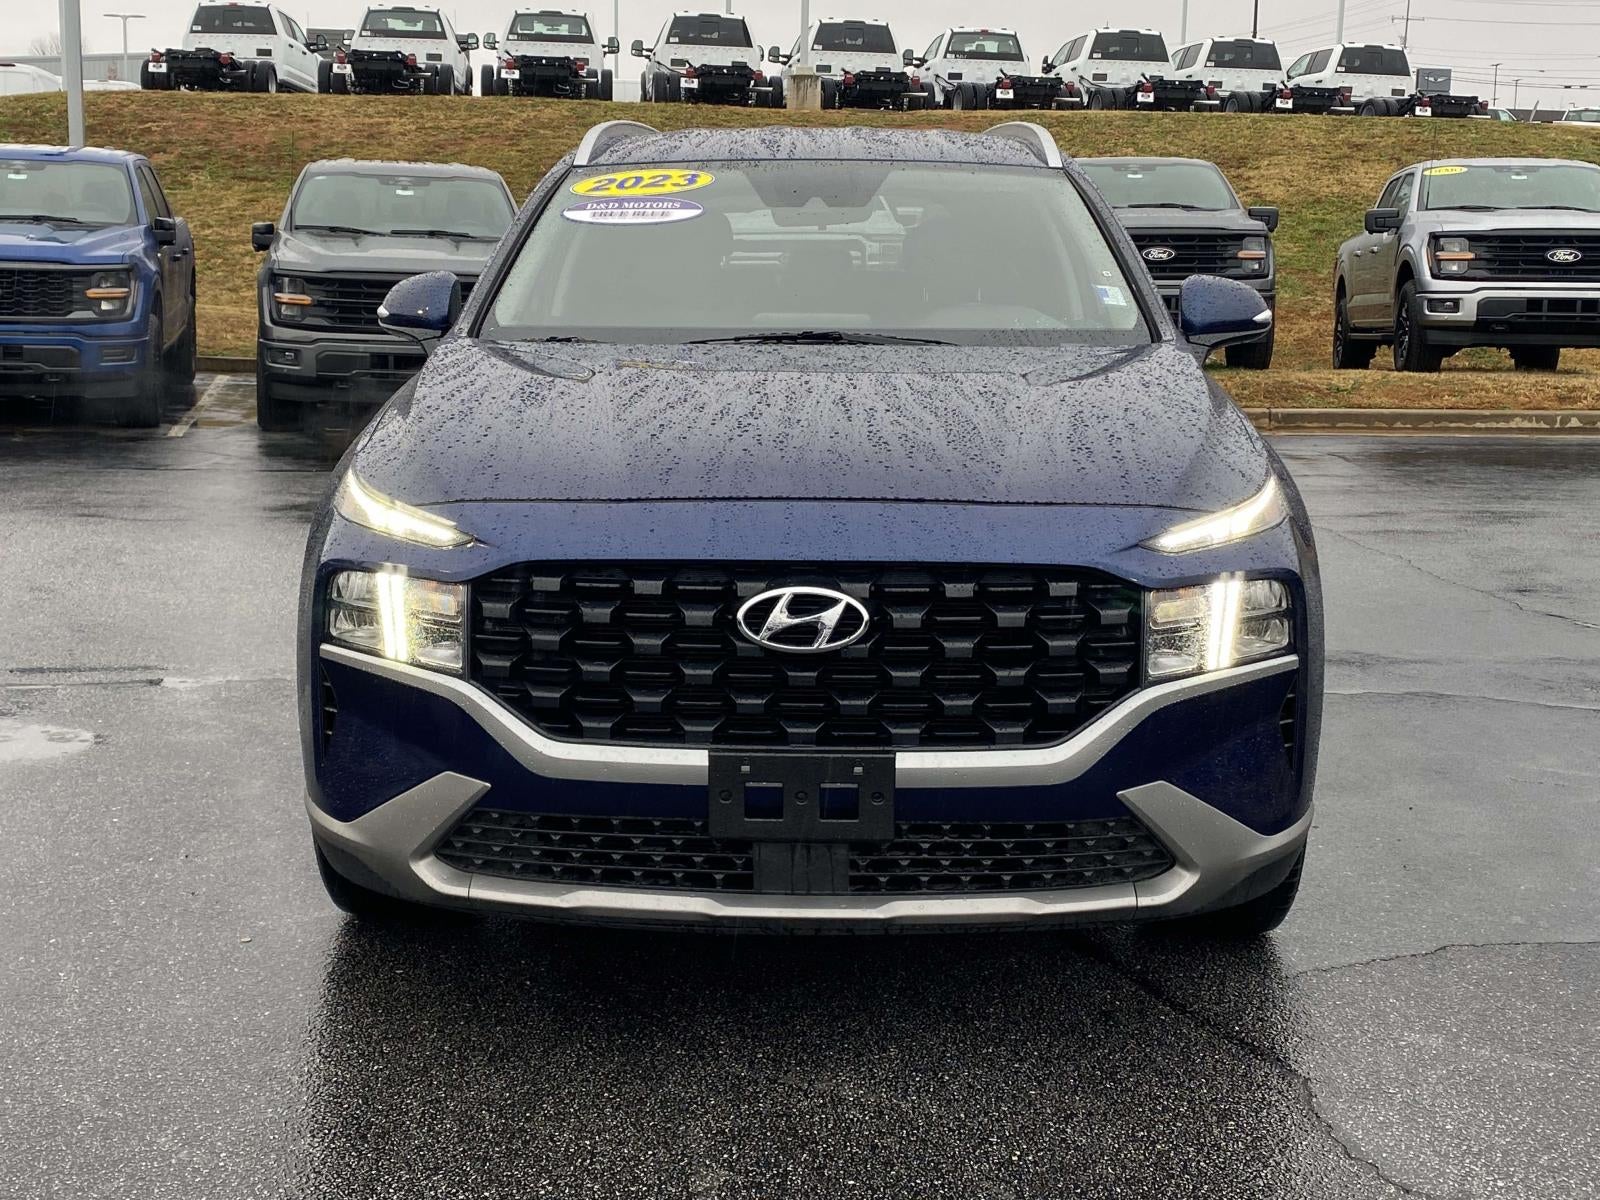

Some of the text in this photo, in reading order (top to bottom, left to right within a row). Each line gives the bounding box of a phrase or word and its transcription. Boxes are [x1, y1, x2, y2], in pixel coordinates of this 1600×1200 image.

[586, 174, 701, 192] 2023
[585, 201, 682, 210] D&D MOTORS
[1148, 248, 1170, 259] Ford
[1553, 249, 1576, 261] Ford
